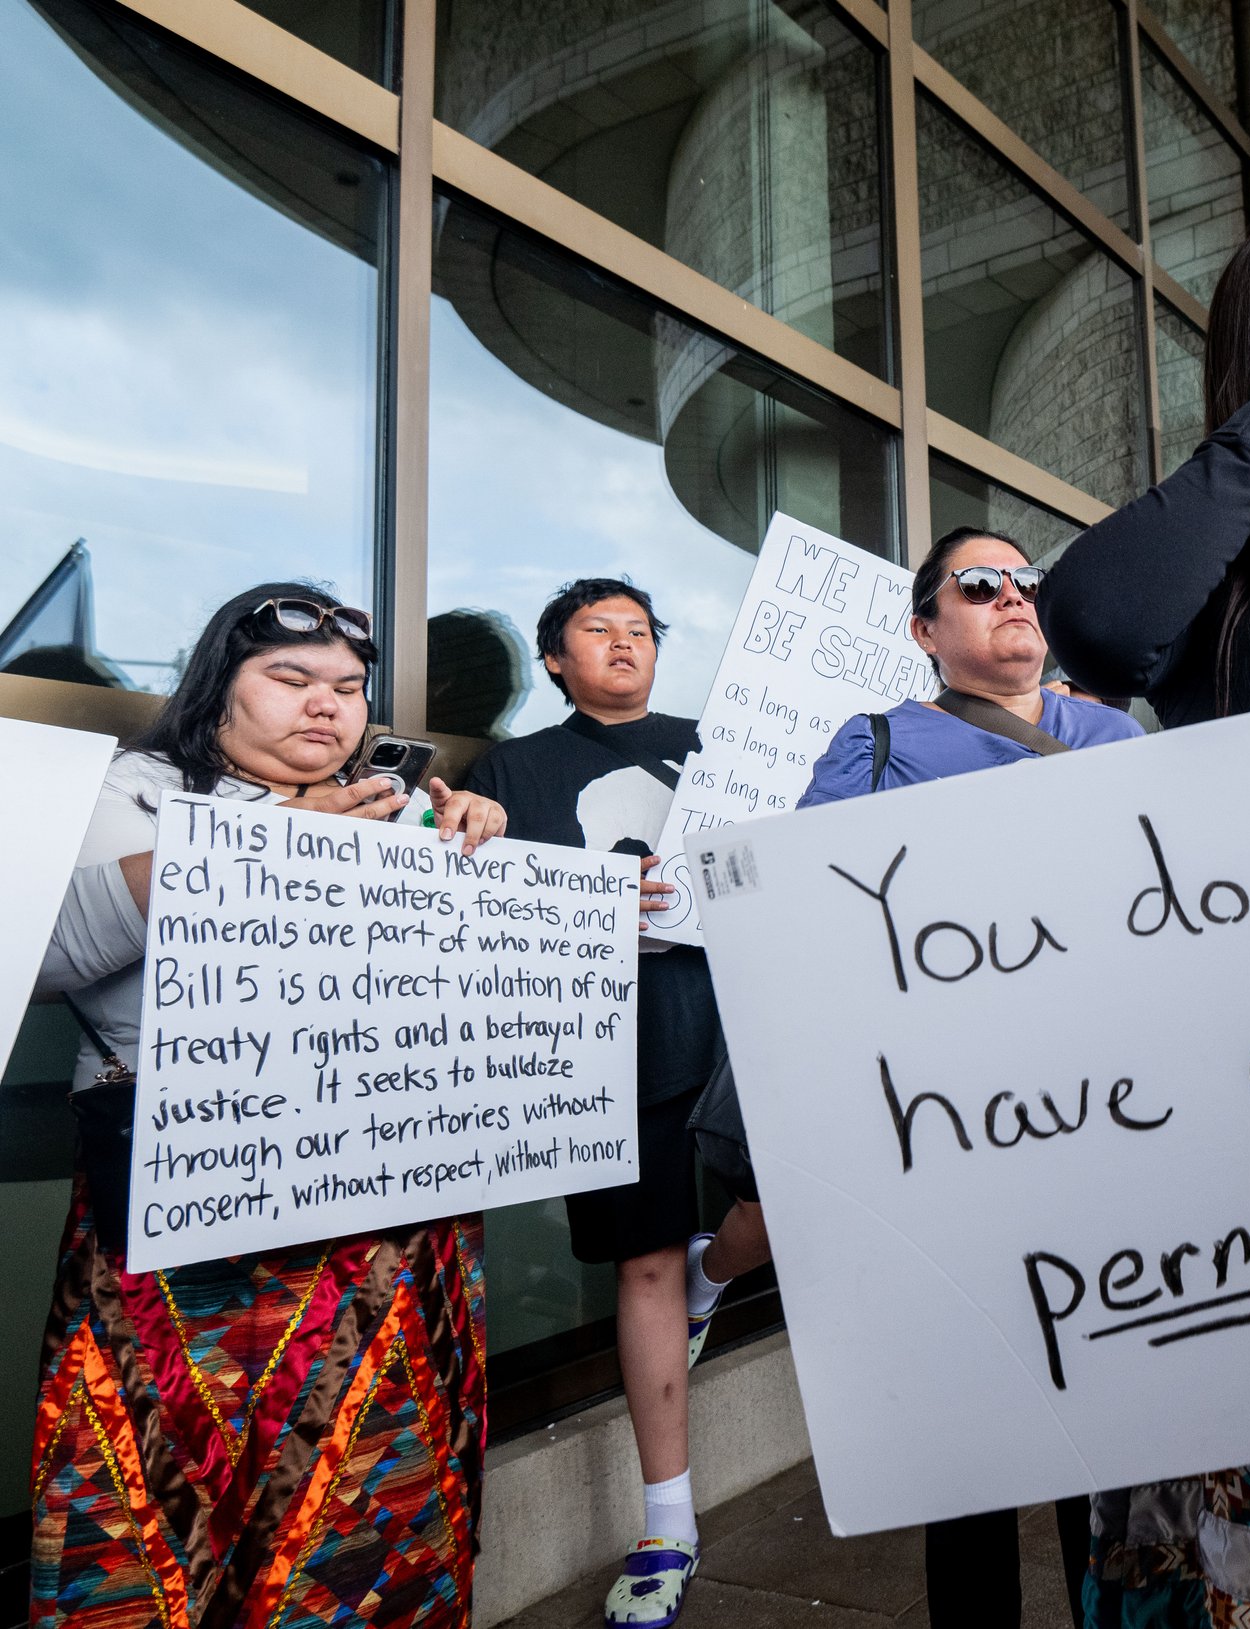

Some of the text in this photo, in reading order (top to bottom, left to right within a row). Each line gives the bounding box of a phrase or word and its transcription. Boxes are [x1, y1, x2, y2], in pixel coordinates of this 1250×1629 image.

[775, 535, 914, 641] WE W
[743, 600, 807, 662] BE
[725, 682, 832, 735] as long as
[712, 726, 807, 768] as long as
[692, 769, 786, 813] as long as
[170, 798, 268, 852] This
[286, 816, 361, 866] land
[377, 841, 434, 874] was
[446, 849, 516, 884] never
[159, 856, 616, 934] ed, These waters, forests, and
[828, 845, 1069, 993] You
[1127, 814, 1250, 936] do
[158, 912, 625, 964] minerals are part of who we are.
[155, 957, 222, 1010] Bill
[235, 964, 260, 1003] 5
[278, 968, 305, 1005] is
[318, 973, 341, 1001] a
[352, 962, 450, 1005] direct
[571, 970, 596, 999] of
[601, 976, 637, 1002] our
[150, 1011, 621, 1077] treaty rights and a betrayal of
[151, 1051, 574, 1131] justice. It seeks to bulldoze
[878, 1053, 1173, 1172] have
[143, 1085, 615, 1184] through our territories without
[291, 1162, 395, 1210] without
[401, 1148, 492, 1194] respect,
[568, 1136, 632, 1165] honor.
